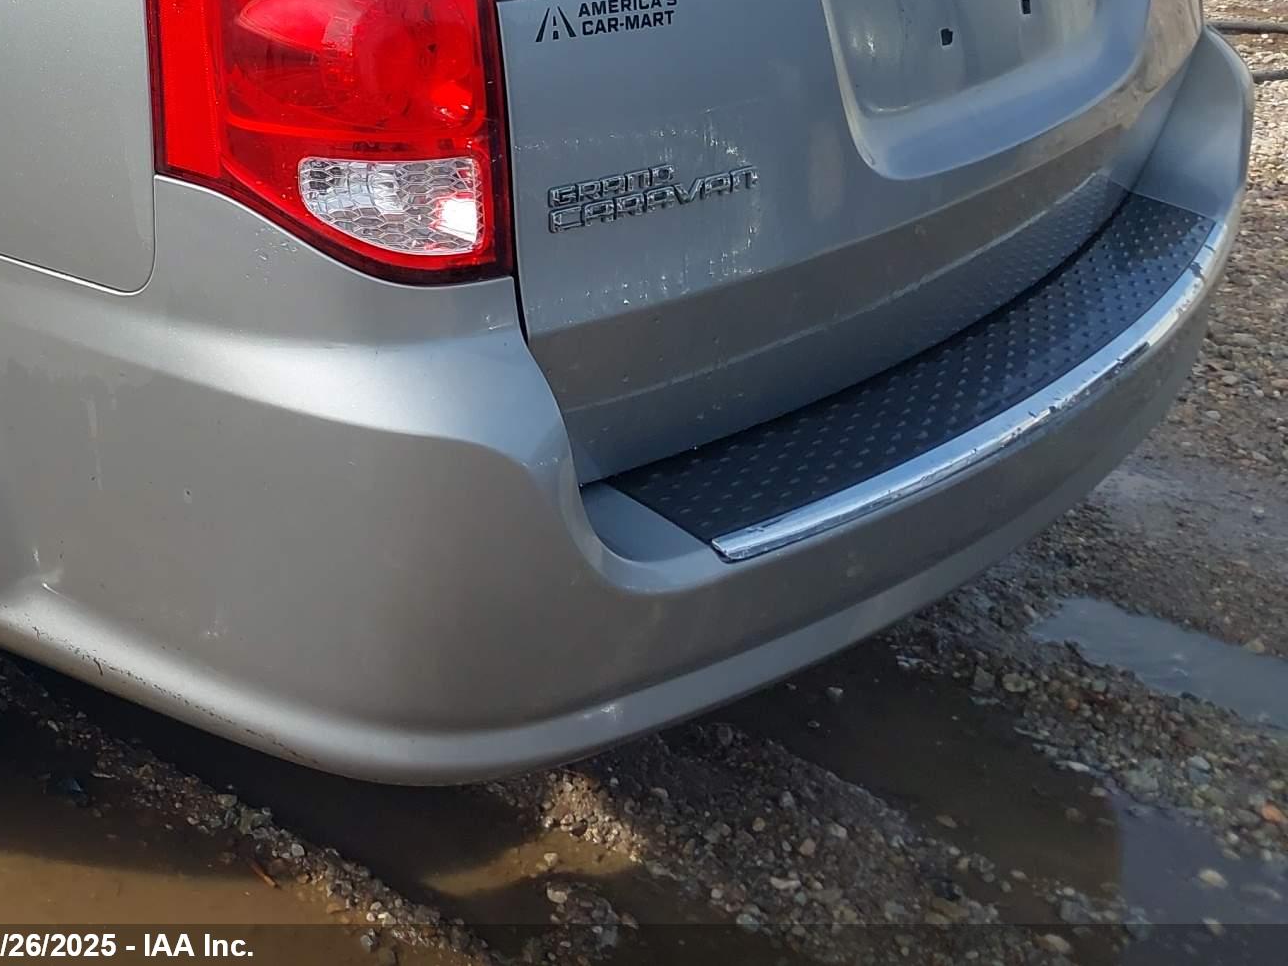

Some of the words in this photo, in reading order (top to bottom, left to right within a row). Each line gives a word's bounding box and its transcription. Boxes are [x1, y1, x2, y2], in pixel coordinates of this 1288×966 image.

[582, 10, 675, 36] CAR-MART
[548, 163, 675, 208] GRAND
[548, 165, 758, 233] CARAVAN
